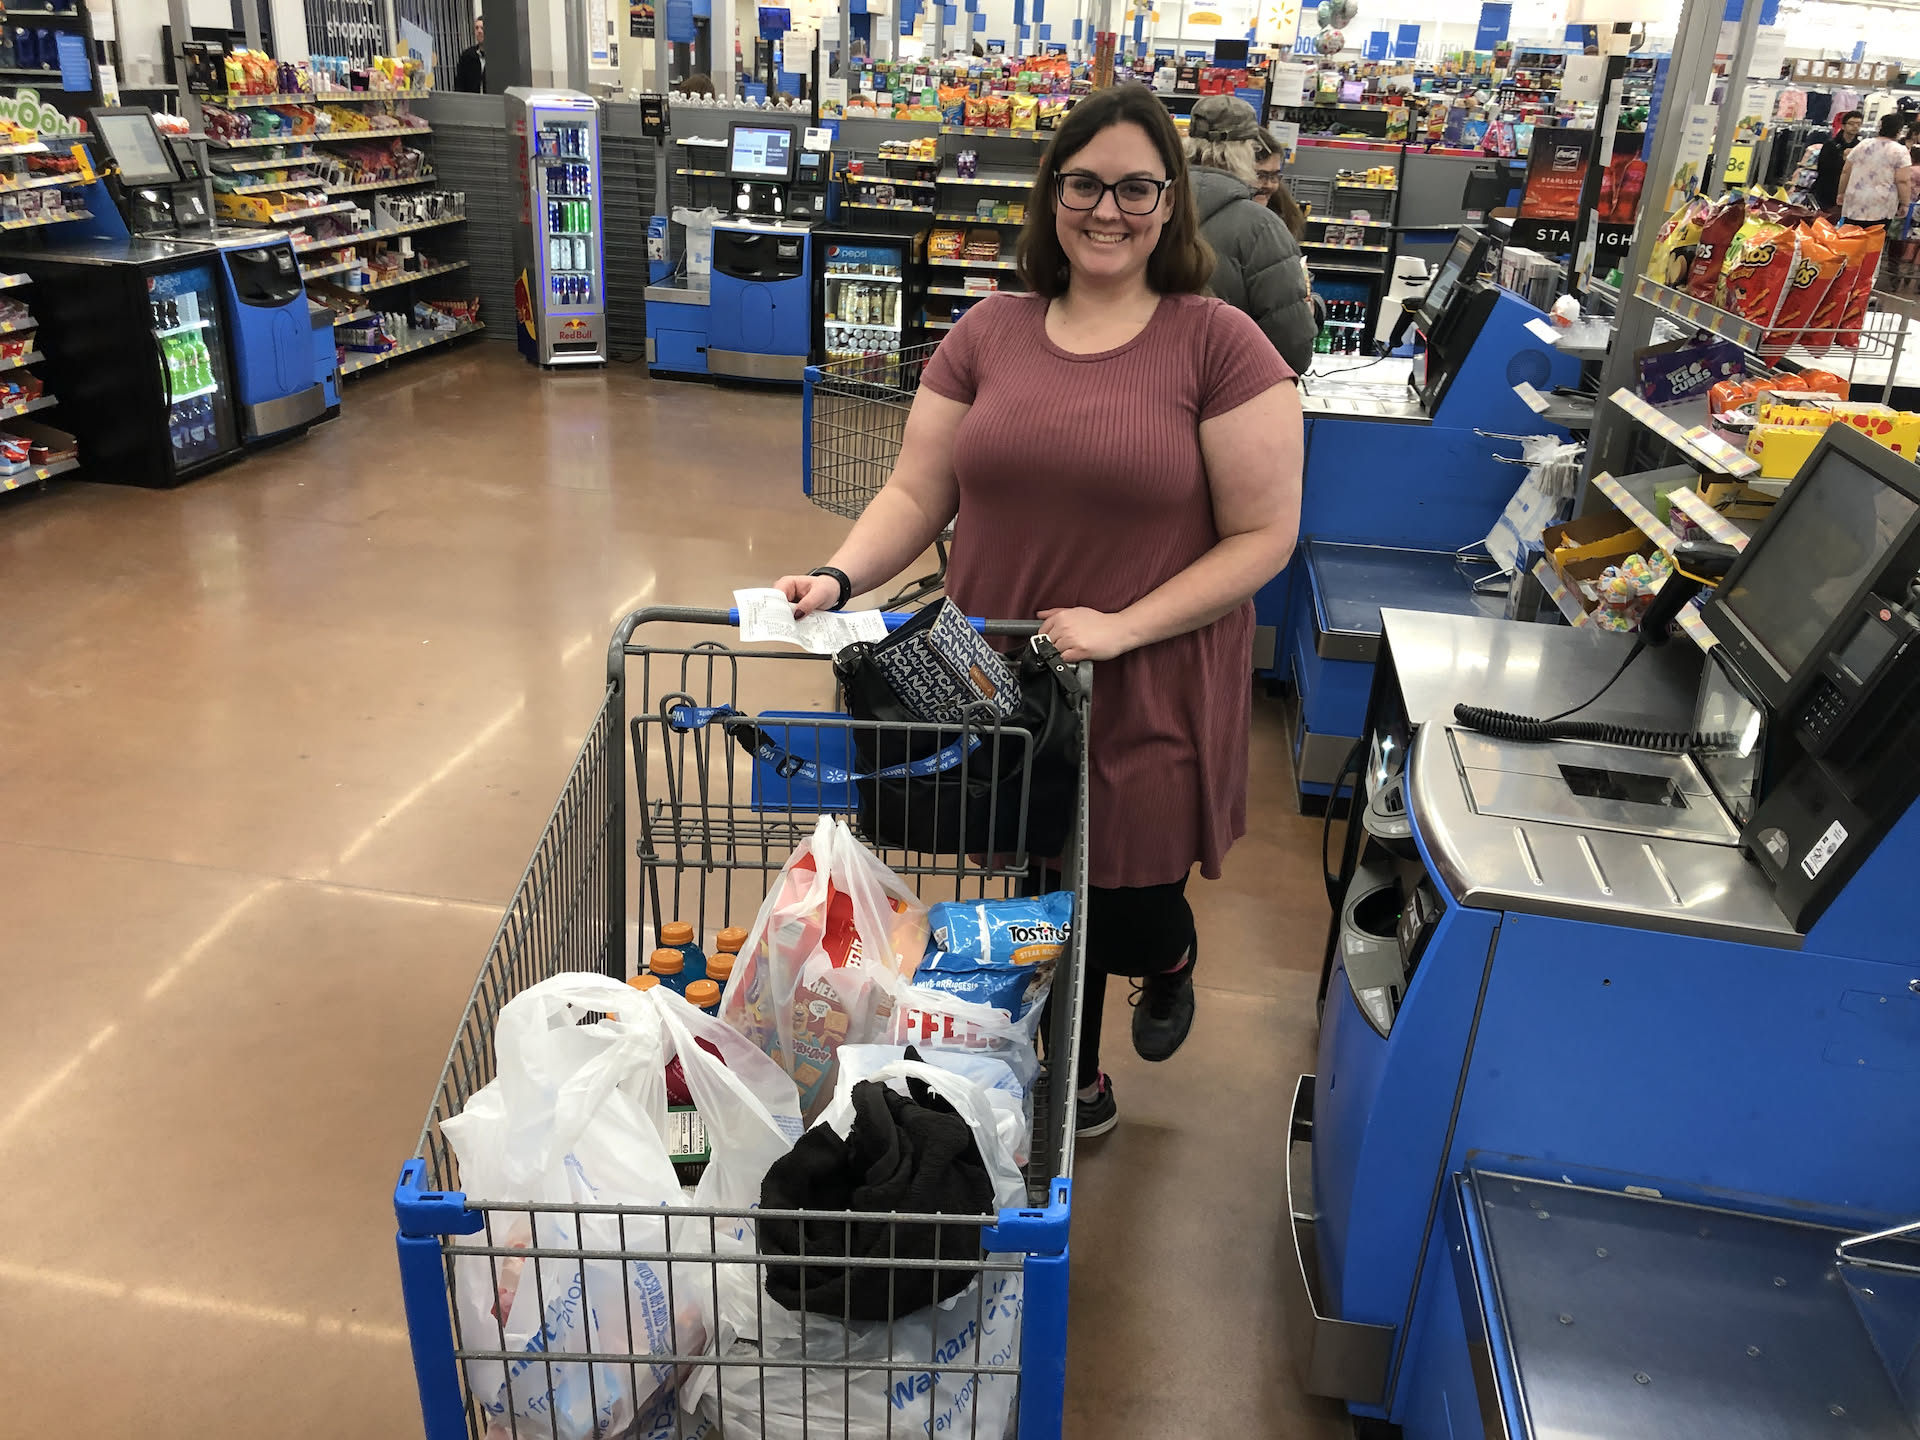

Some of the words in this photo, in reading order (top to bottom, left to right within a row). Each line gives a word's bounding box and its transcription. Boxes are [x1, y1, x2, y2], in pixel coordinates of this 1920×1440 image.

[327, 17, 382, 47] shopping
[841, 249, 868, 259] pepsi
[559, 331, 576, 340] Red
[576, 330, 592, 339] Bull
[1671, 369, 1691, 386] ICE
[1671, 368, 1712, 395] CUBES
[904, 649, 934, 687] NAUTICA
[908, 637, 955, 696] NAUTICA
[946, 620, 974, 656] NAUTICA
[974, 655, 1002, 688] NAUTICA
[972, 636, 1014, 689] NAUTICA
[1019, 950, 1041, 960] STEAK
[682, 1144, 689, 1154] 60
[884, 1319, 978, 1411] Wamart
